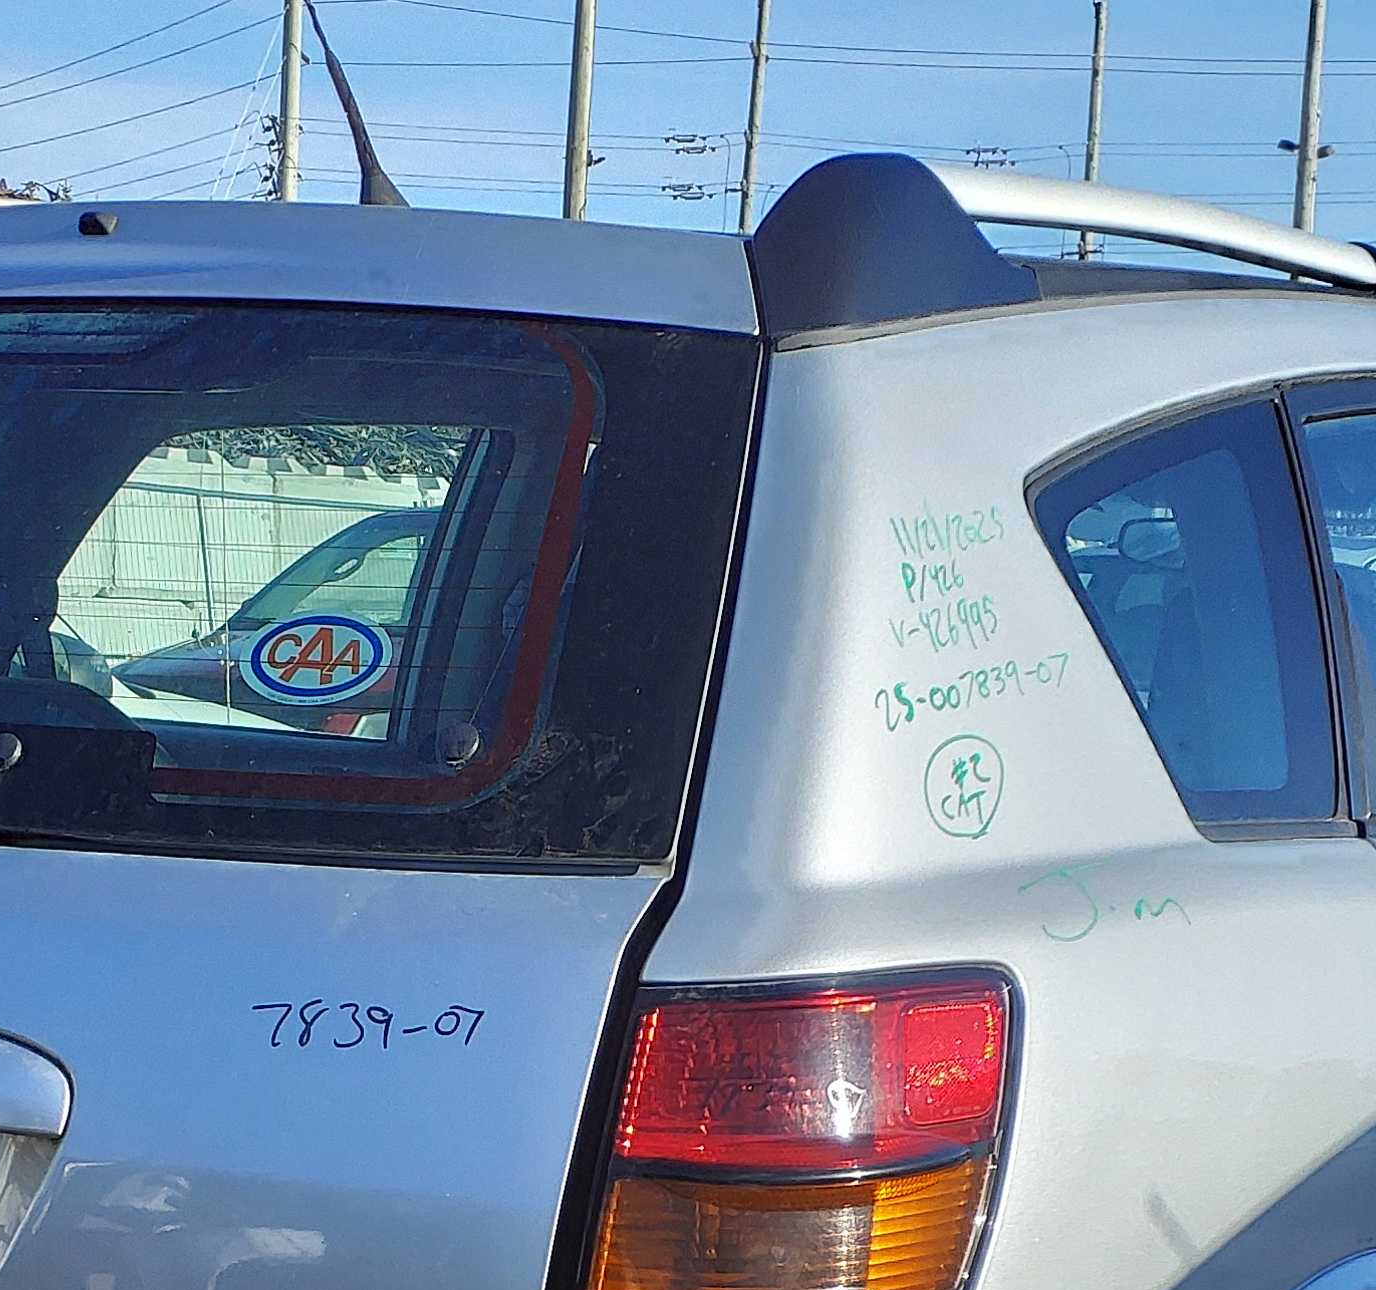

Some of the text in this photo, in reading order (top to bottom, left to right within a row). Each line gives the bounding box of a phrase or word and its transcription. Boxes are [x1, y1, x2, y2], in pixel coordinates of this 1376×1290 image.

[266, 626, 361, 686] CAA
[875, 652, 1070, 732] 25-007839-07
[940, 789, 988, 825] CAT
[251, 998, 486, 1050] 7839-07
